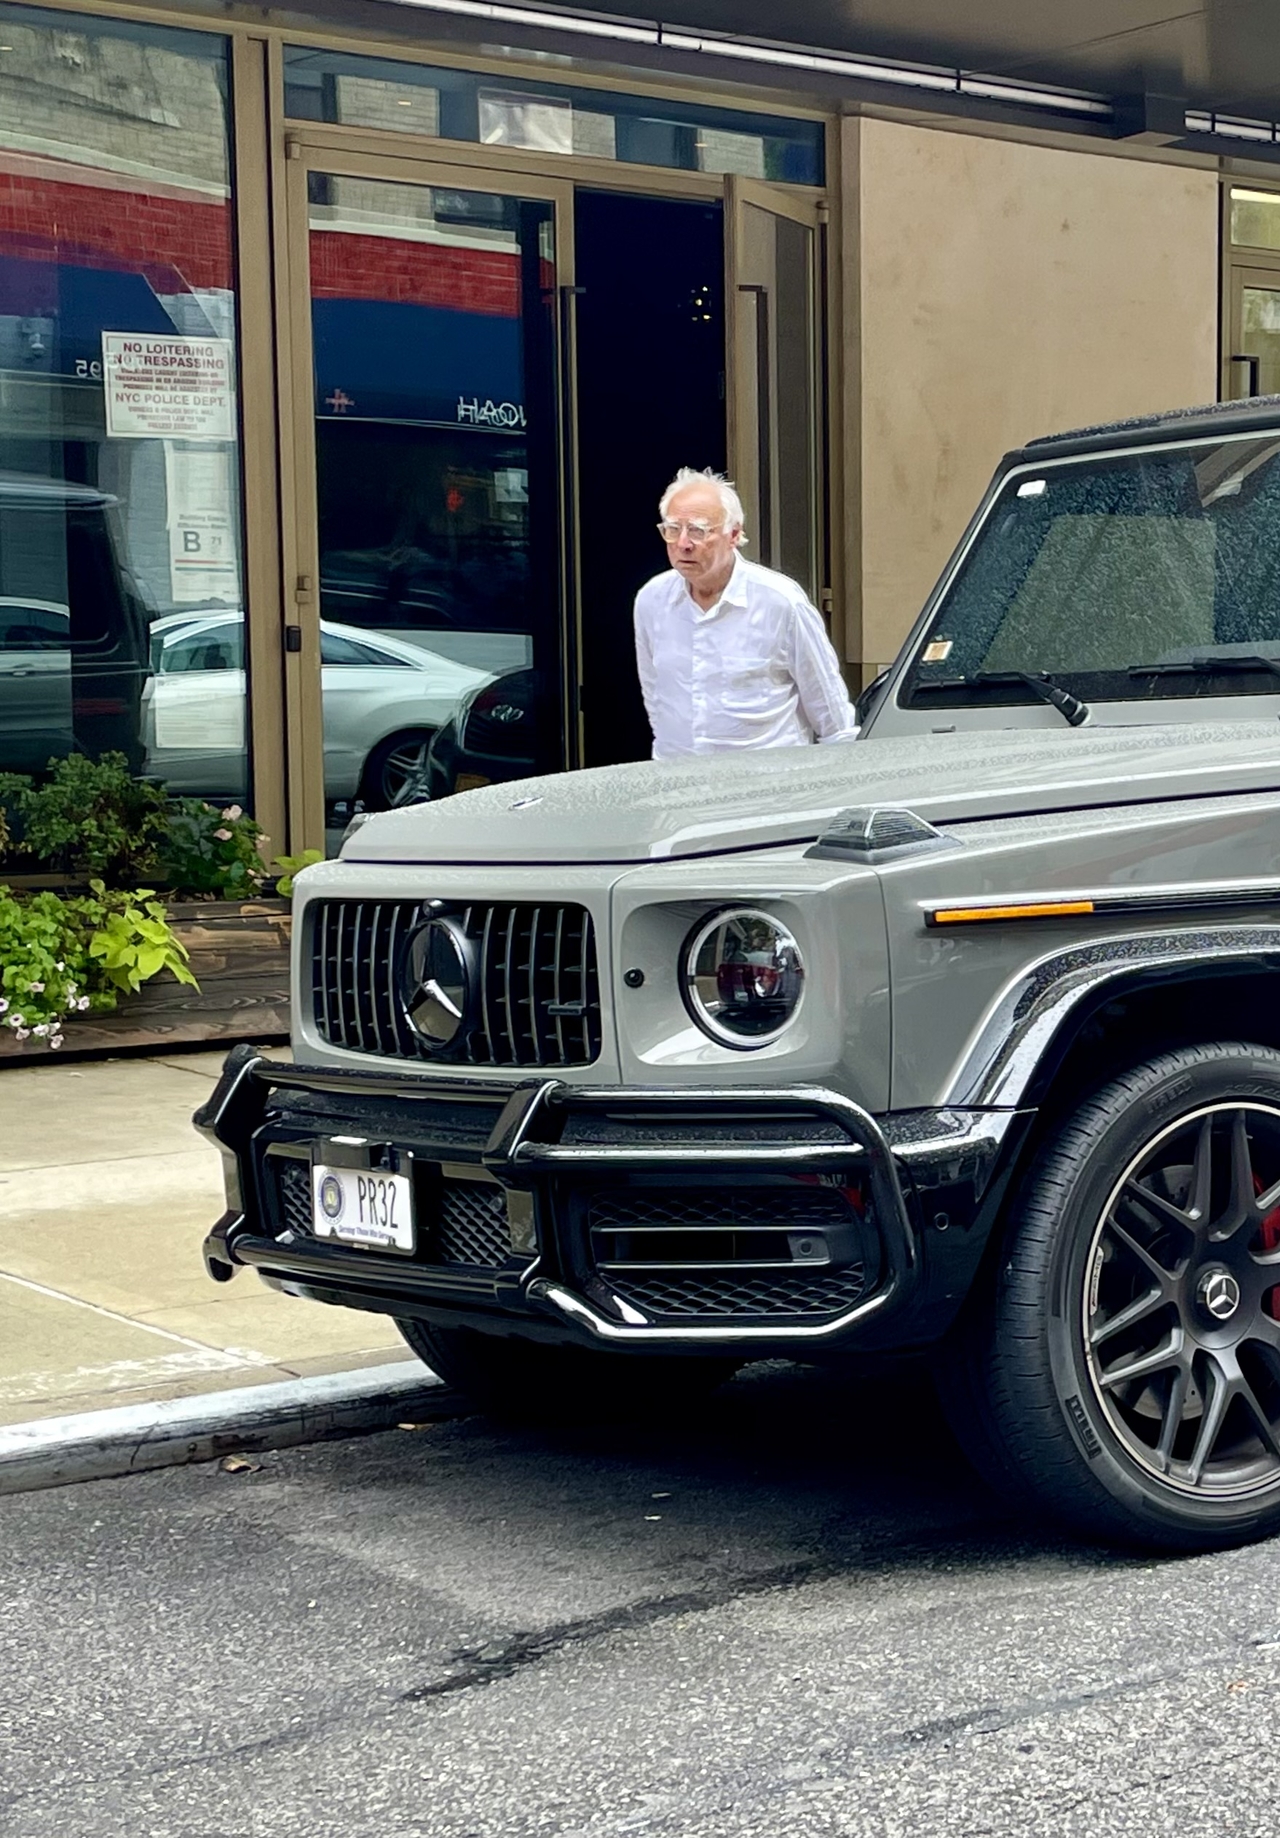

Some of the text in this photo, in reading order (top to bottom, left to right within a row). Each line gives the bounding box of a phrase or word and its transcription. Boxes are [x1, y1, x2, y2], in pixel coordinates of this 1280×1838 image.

[123, 342, 214, 357] NO LOITERING
[113, 353, 225, 369] NO TRESPASSING
[115, 393, 227, 408] NYC POLICE DEPT.
[183, 531, 201, 552] B
[357, 1175, 399, 1229] PR32
